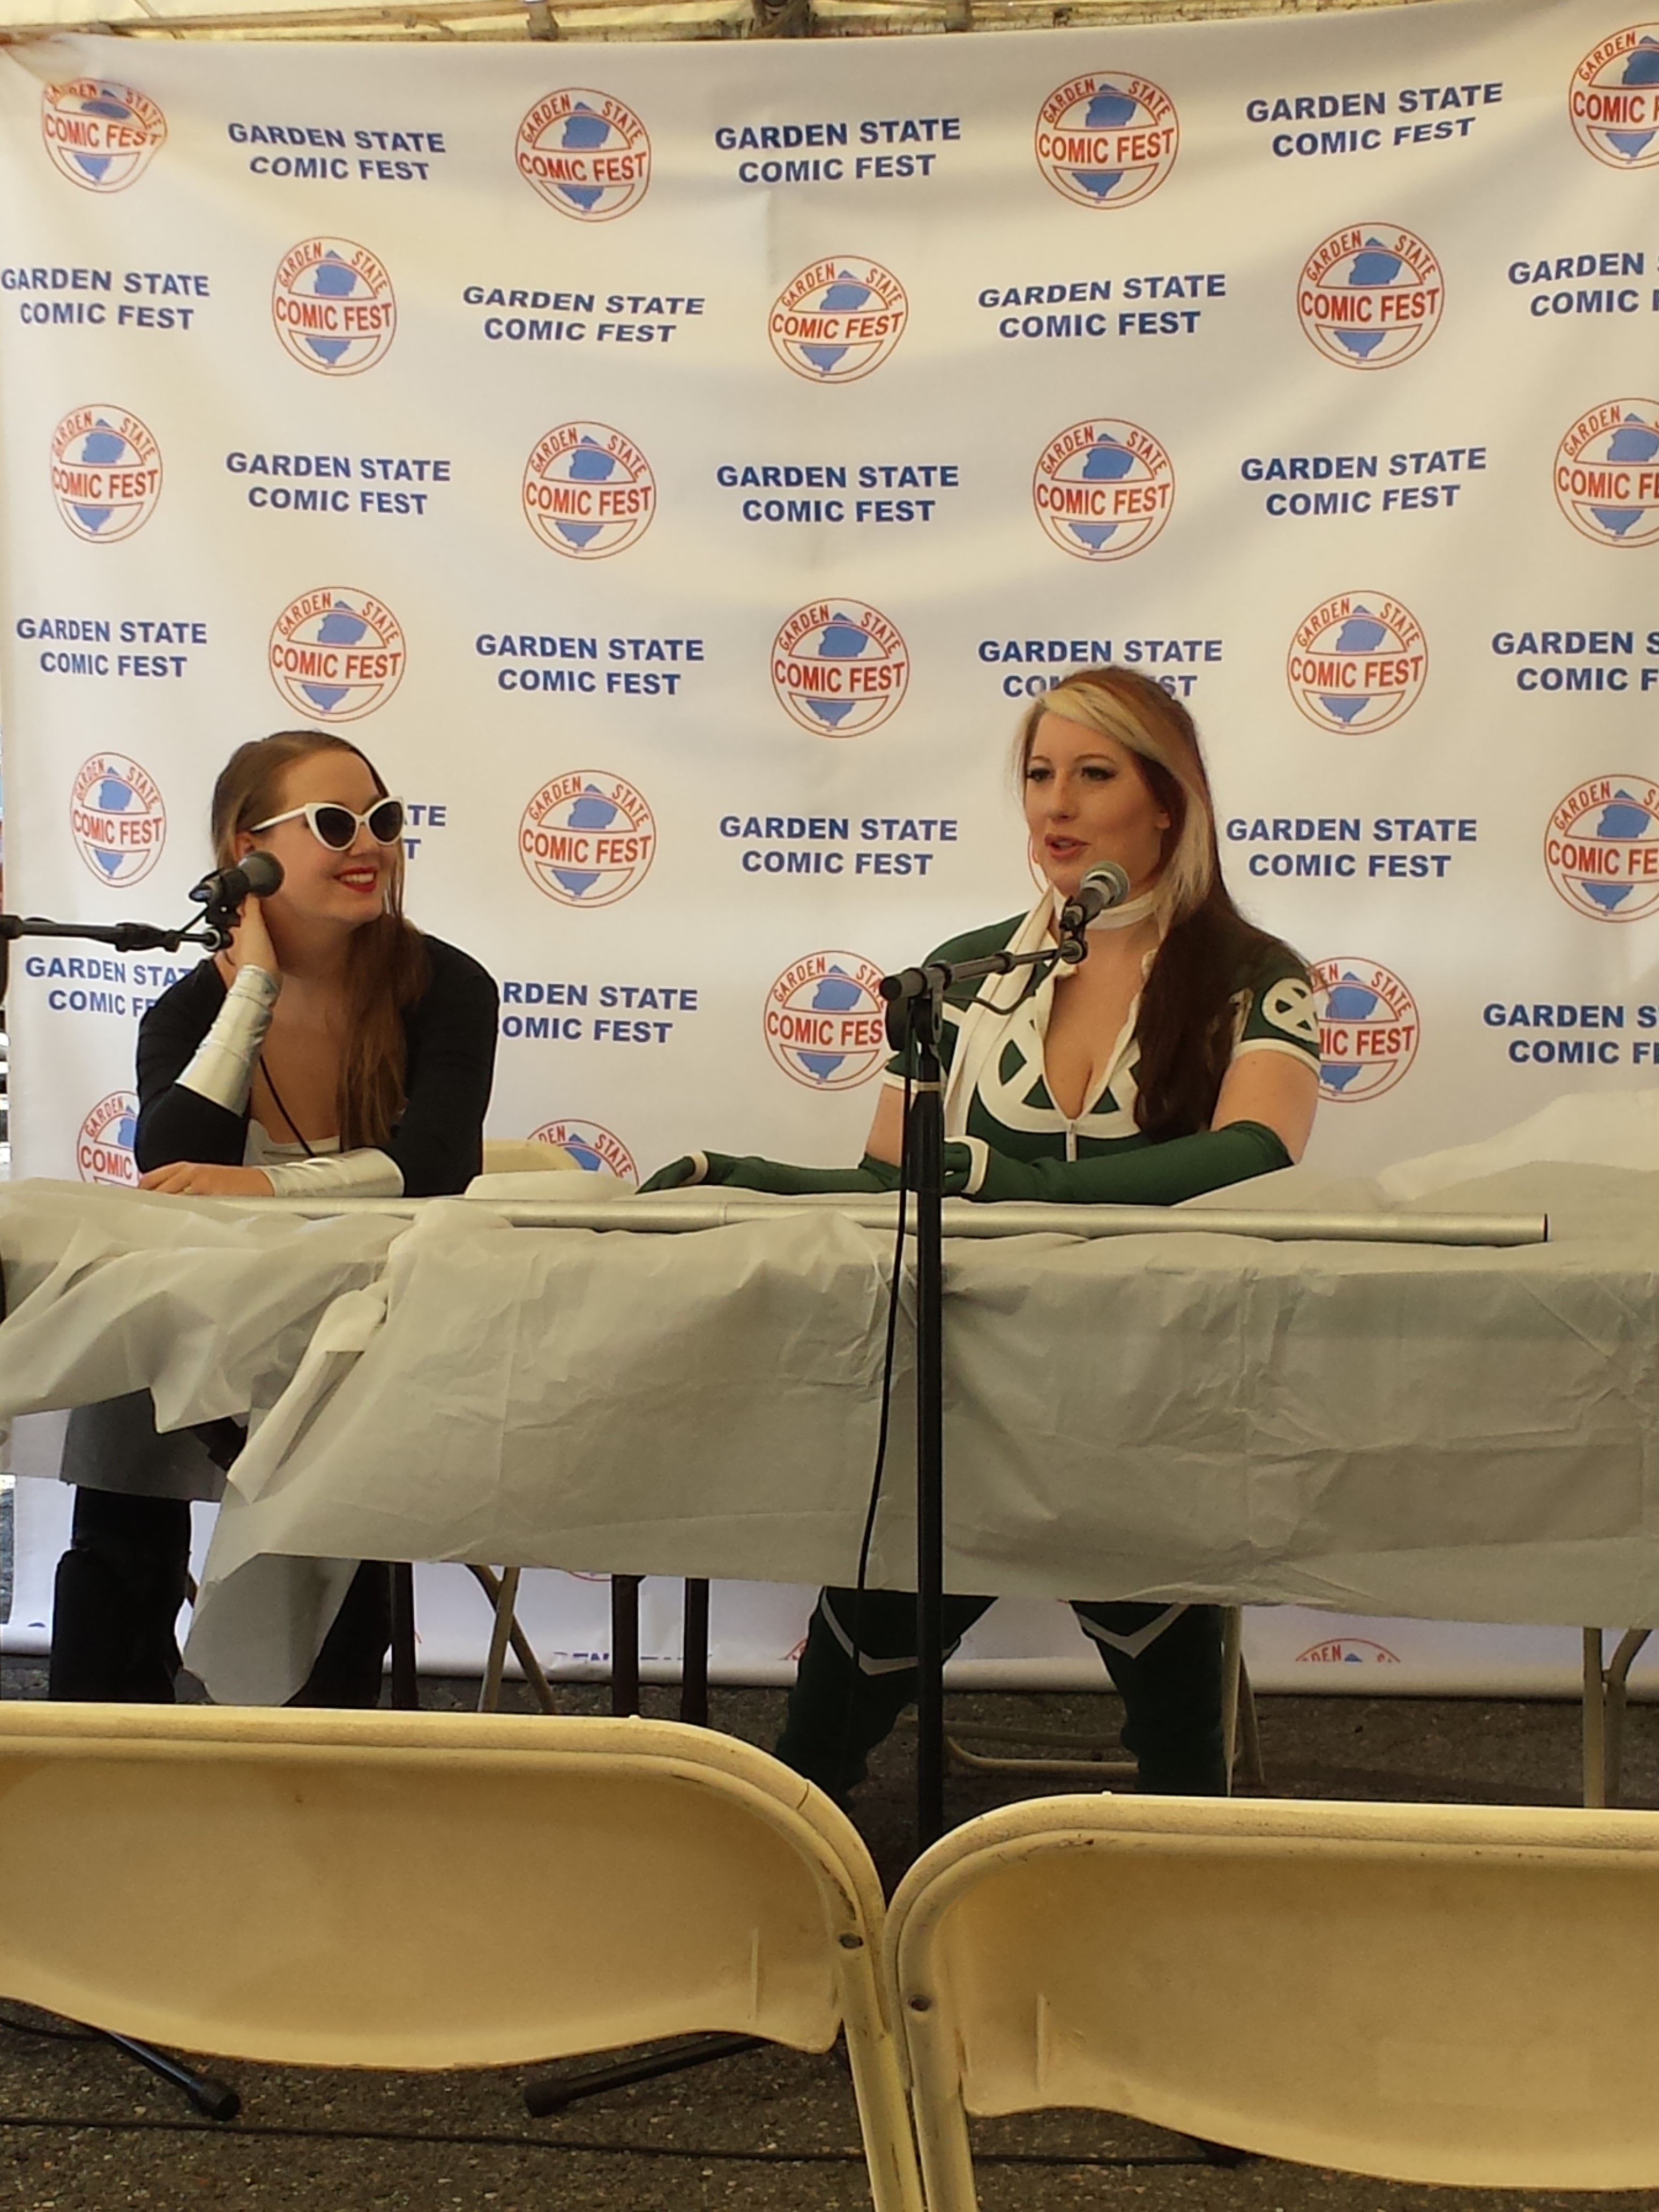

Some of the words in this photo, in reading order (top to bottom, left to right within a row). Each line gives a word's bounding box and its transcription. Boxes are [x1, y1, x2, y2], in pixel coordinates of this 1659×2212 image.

[1579, 31, 1635, 80] GARDEN
[126, 88, 161, 129] STATE
[1042, 79, 1095, 124] GARDEN
[1128, 81, 1171, 123] STATE
[1247, 92, 1385, 122] GARDEN
[1400, 83, 1501, 112] STATE
[1573, 91, 1645, 123] COMIC
[44, 113, 99, 147] COMIC
[107, 124, 162, 148] FEST
[521, 94, 571, 143] GARDEN
[601, 101, 643, 145] STATE
[716, 123, 847, 150] GARDEN
[861, 118, 960, 143] STATE
[229, 123, 345, 147] GARDEN
[354, 131, 446, 153] STATE
[1038, 133, 1108, 163] COMIC
[1117, 128, 1175, 163] FEST
[1273, 130, 1380, 156] COMIC
[1394, 118, 1474, 145] FEST
[250, 156, 348, 179] COMIC
[359, 160, 429, 180] FEST
[519, 153, 587, 181] COMIC
[593, 152, 647, 181] FEST
[739, 159, 843, 183] COMIC
[856, 154, 935, 178] FEST
[278, 242, 323, 289] GARDEN
[351, 250, 387, 295] STATE
[1306, 230, 1361, 282] GARDEN
[1394, 234, 1436, 281] STATE
[1508, 253, 1643, 284] GARDEN
[2, 268, 111, 290] GARDEN
[124, 273, 209, 296] STATE
[781, 263, 835, 308] GARDEN
[866, 268, 903, 308] STATE
[979, 281, 1110, 307] GARDEN
[1124, 274, 1225, 298] STATE
[276, 296, 337, 331] COMIC
[345, 303, 392, 332] FEST
[464, 286, 594, 312] GARDEN
[607, 296, 704, 314] STATE
[1302, 290, 1372, 322] COMIC
[1380, 288, 1439, 322] FEST
[1531, 290, 1638, 316] COMIC
[21, 303, 105, 324] COMIC
[118, 305, 193, 330] FEST
[485, 318, 584, 340] COMIC
[597, 324, 674, 342] FEST
[772, 314, 840, 339] COMIC
[845, 311, 903, 338] FEST
[1000, 314, 1106, 338] COMIC
[1119, 311, 1201, 335] FEST
[120, 417, 155, 461] STATE
[1563, 405, 1620, 456] GARDEN
[227, 452, 350, 477] GARDEN
[361, 459, 450, 481] STATE
[530, 427, 577, 474] GARDEN
[608, 435, 648, 477] STATE
[1041, 427, 1094, 475] GARDEN
[1127, 430, 1167, 474] STATE
[1242, 456, 1377, 481] GARDEN
[1389, 447, 1485, 475] STATE
[109, 469, 158, 498] FEST
[717, 466, 846, 488] GARDEN
[859, 466, 958, 488] STATE
[1558, 467, 1630, 499] COMIC
[249, 487, 349, 511] COMIC
[361, 491, 427, 514] FEST
[525, 482, 592, 515] COMIC
[599, 485, 651, 515] FEST
[743, 500, 844, 522] COMIC
[856, 500, 936, 522] FEST
[1037, 483, 1105, 515] COMIC
[1114, 483, 1170, 515] FEST
[1266, 491, 1371, 515] COMIC
[1383, 485, 1460, 510] FEST
[17, 618, 109, 641] GARDEN
[121, 622, 207, 644] STATE
[278, 592, 331, 636] GARDEN
[362, 601, 399, 644] STATE
[779, 605, 829, 651] GARDEN
[861, 611, 901, 654] STATE
[1298, 599, 1350, 647] GARDEN
[1380, 603, 1420, 646] STATE
[476, 634, 597, 659] GARDEN
[609, 639, 704, 661] STATE
[978, 641, 1111, 662] GARDEN
[1124, 640, 1222, 662] STATE
[1492, 632, 1633, 654] GARDEN
[41, 652, 108, 675] COMIC
[118, 656, 187, 677] FEST
[272, 645, 338, 678] COMIC
[346, 652, 401, 679] FEST
[774, 660, 841, 692] COMIC
[849, 662, 905, 692] FEST
[1290, 657, 1357, 688] COMIC
[1364, 656, 1424, 688] FEST
[498, 669, 596, 692] COMIC
[607, 672, 681, 694] FEST
[1517, 668, 1628, 691] COMIC
[128, 767, 160, 810] STATE
[528, 776, 582, 822] GARDEN
[612, 784, 649, 828] STATE
[1554, 781, 1611, 830] GARDEN
[73, 810, 114, 844] COMIC
[120, 818, 162, 845] FEST
[720, 816, 848, 839] GARDEN
[861, 819, 957, 841] STATE
[1228, 819, 1360, 841] GARDEN
[1373, 819, 1477, 841] STATE
[522, 828, 588, 864] COMIC
[596, 835, 652, 864] FEST
[1548, 839, 1620, 875] COMIC
[743, 851, 843, 873] COMIC
[856, 854, 933, 875] FEST
[1250, 854, 1355, 877] COMIC
[1369, 855, 1451, 877] FEST
[26, 957, 125, 983] GARDEN
[774, 956, 825, 1002] GARDEN
[49, 990, 125, 1014] COMIC
[504, 982, 587, 1005] RDEN
[600, 987, 697, 1010] STATE
[1372, 971, 1411, 1017] STATE
[503, 1017, 581, 1040] OMIC
[594, 1020, 672, 1043] FEST
[768, 1011, 833, 1045] COMIC
[841, 1019, 883, 1046] FES
[1484, 1004, 1624, 1028] GARDEN
[1356, 1025, 1415, 1056] FEST
[1509, 1040, 1619, 1064] COMIC
[81, 1146, 132, 1180] COMIC
[595, 1134, 631, 1178] STATE
